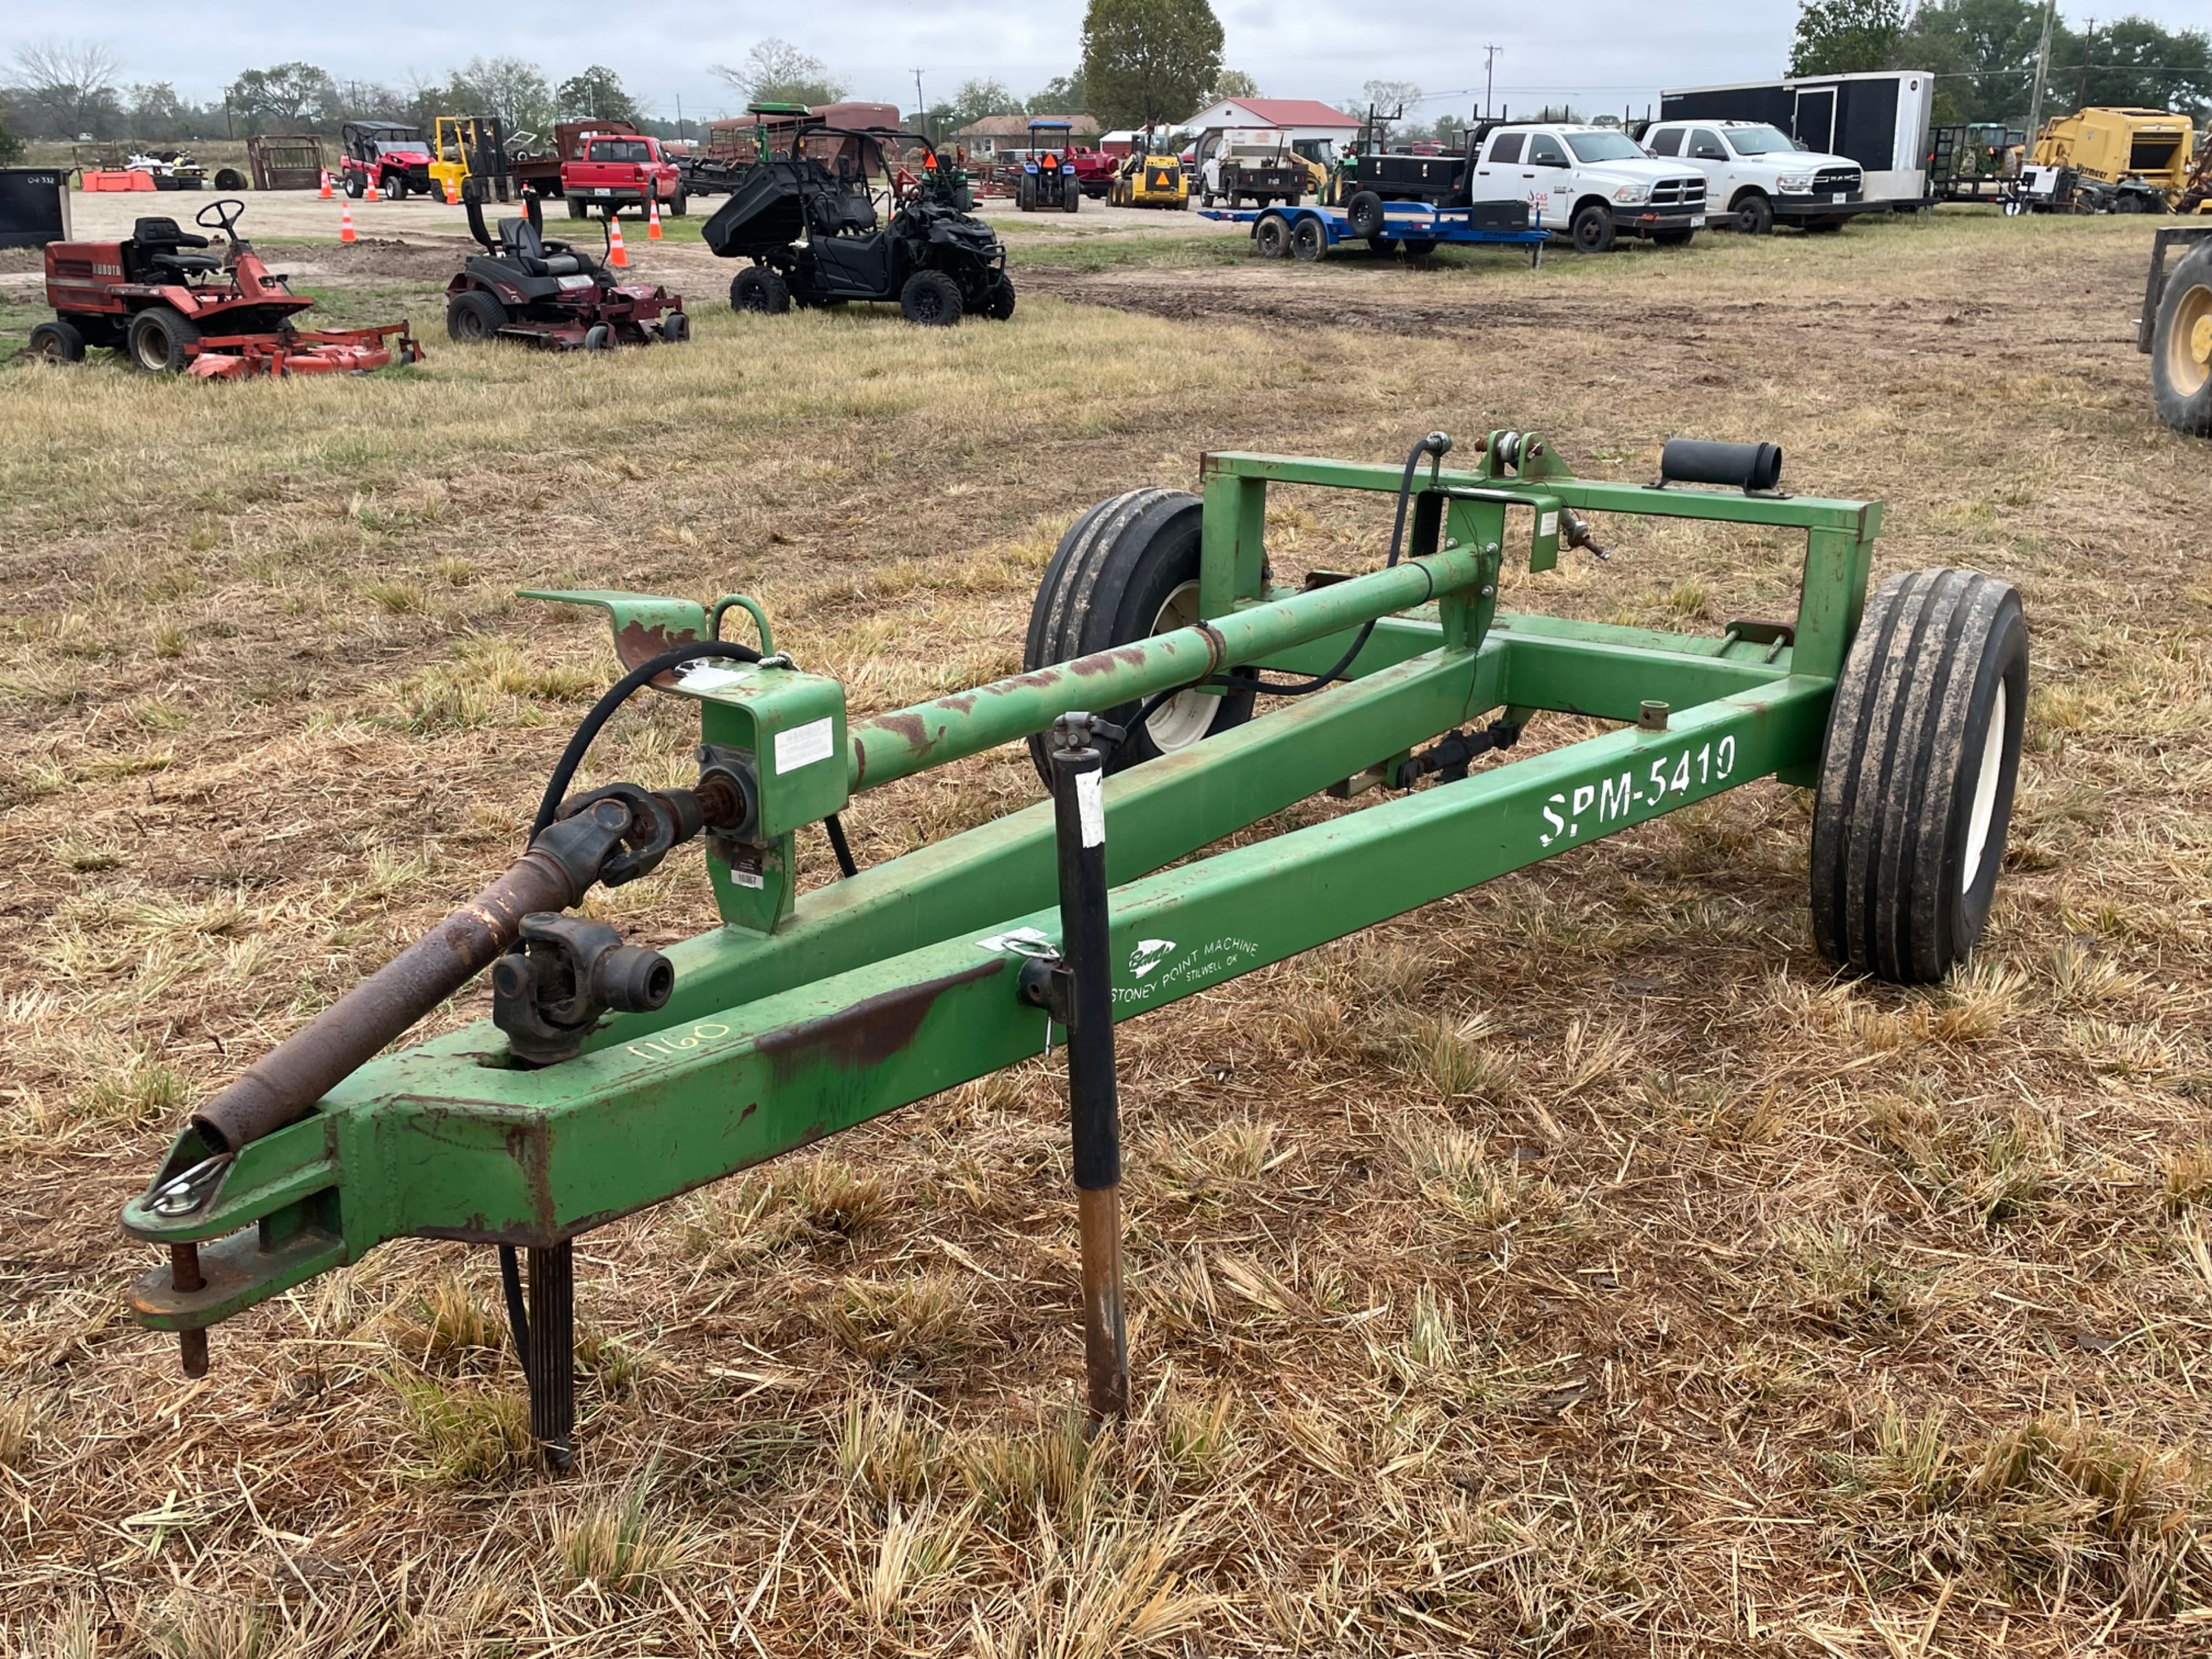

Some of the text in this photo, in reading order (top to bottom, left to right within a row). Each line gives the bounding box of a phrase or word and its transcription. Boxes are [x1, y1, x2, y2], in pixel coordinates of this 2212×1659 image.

[1535, 192, 1548, 201] C&S
[92, 263, 121, 276] KUBOTA
[1540, 735, 1735, 848] SPM-5410
[1111, 980, 1158, 1003] STONEY
[1162, 950, 1199, 988] POINT
[1204, 937, 1259, 957] MACHINE
[1186, 954, 1238, 982] STILWELL OK
[626, 1024, 730, 1060] 1160
